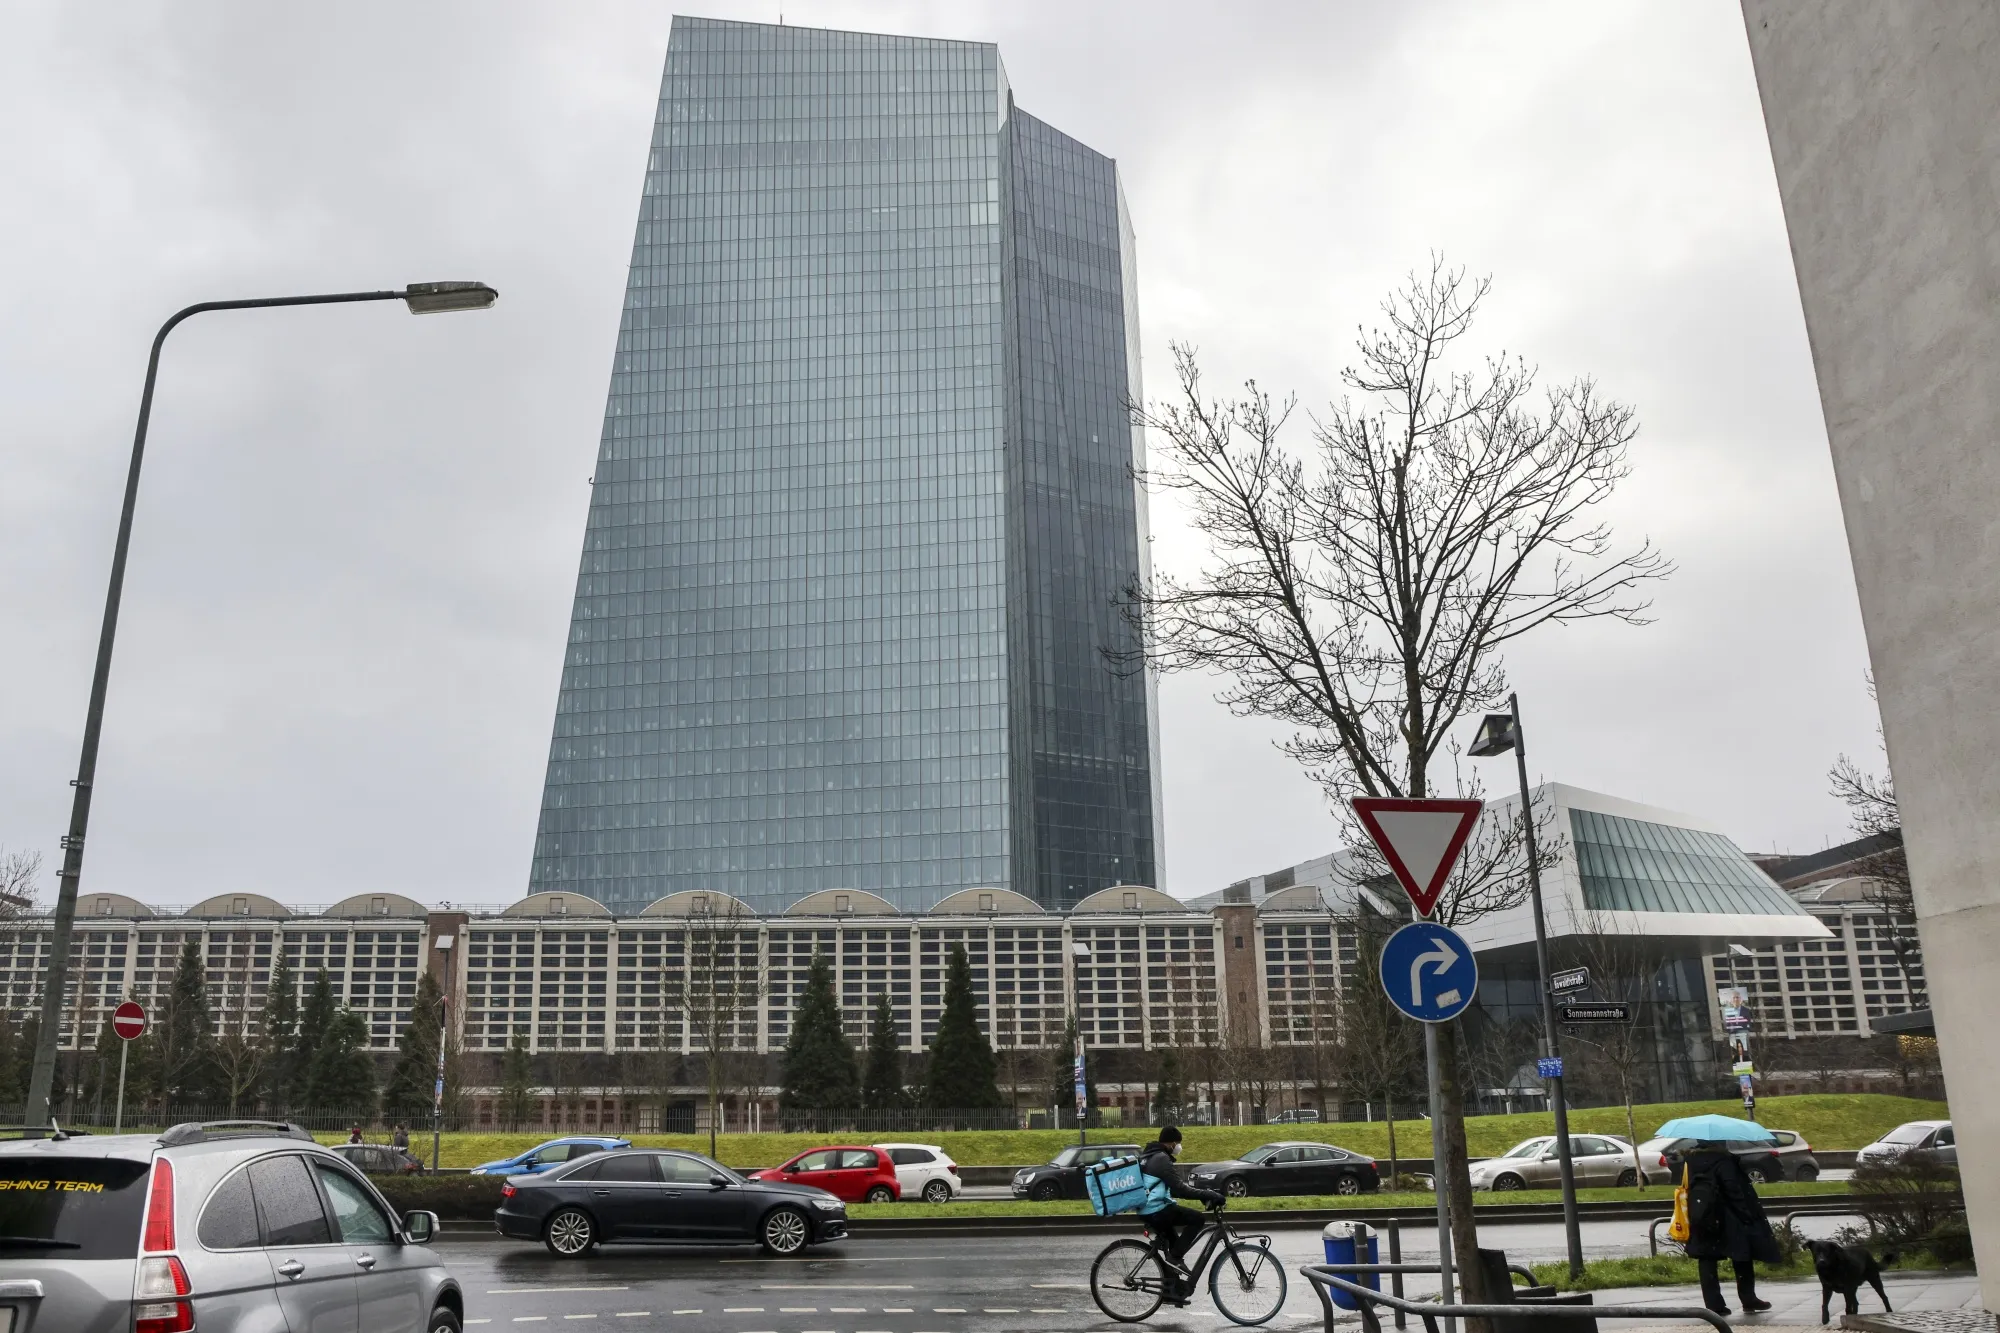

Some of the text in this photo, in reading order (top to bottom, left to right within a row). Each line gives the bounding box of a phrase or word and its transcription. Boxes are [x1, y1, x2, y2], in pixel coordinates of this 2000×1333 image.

[1566, 1008, 1624, 1018] Sonnemannstraße
[54, 1180, 105, 1193] TEAM
[1108, 1175, 1137, 1191] Wolt
